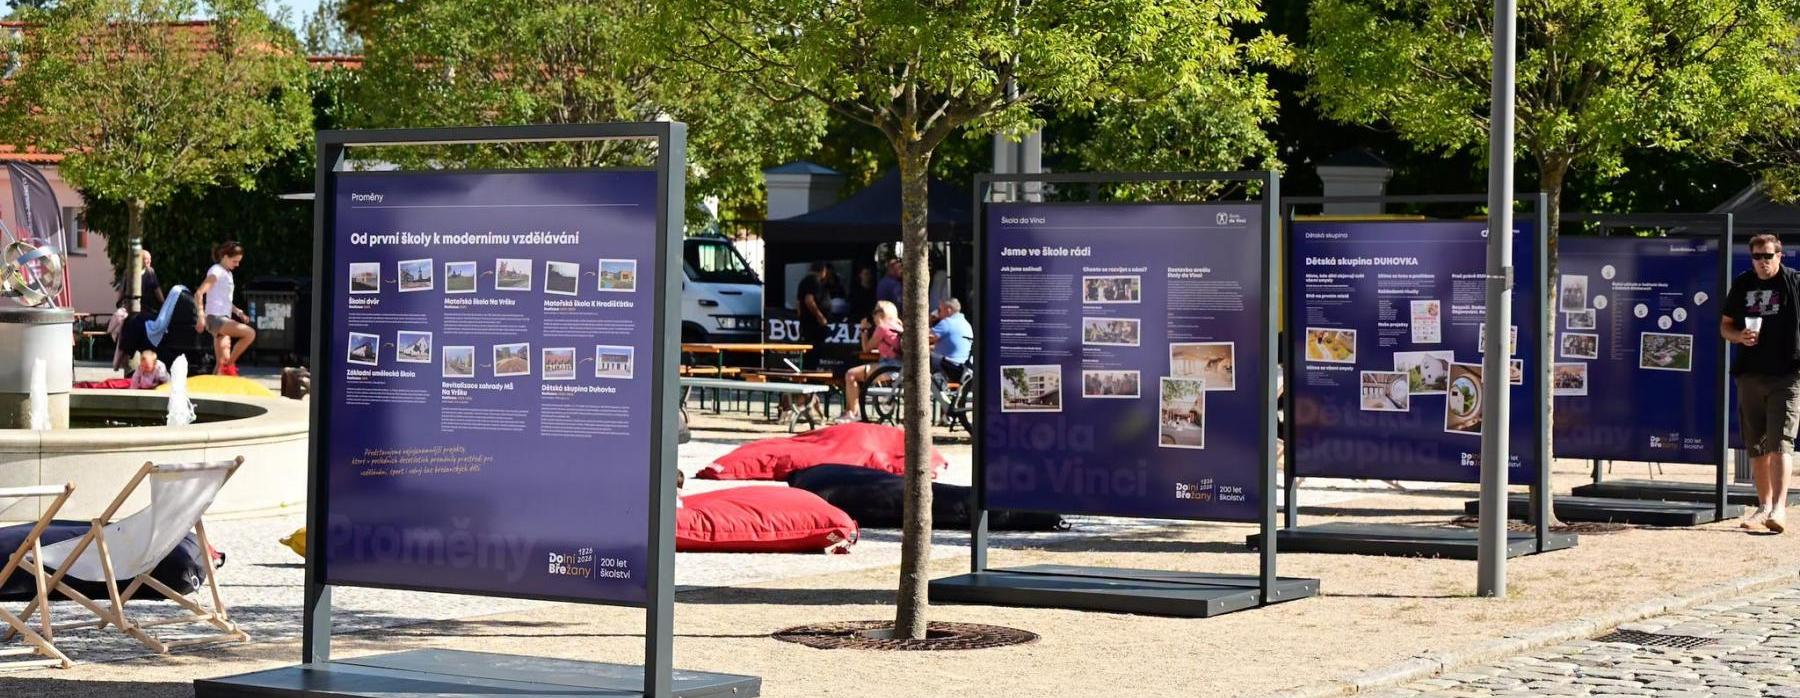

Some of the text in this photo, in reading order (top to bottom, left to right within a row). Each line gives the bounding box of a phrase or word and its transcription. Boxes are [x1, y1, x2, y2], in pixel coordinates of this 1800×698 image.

[351, 192, 384, 203] Proměny
[1030, 216, 1046, 224] Vinci
[350, 230, 580, 248] Od první školy k modernímu vzdělávání
[1000, 245, 1091, 257] Jsme ve škole rádi
[1305, 256, 1418, 267] Dětská skupina DUHOVKA
[348, 296, 380, 305] Školní dvůr
[443, 297, 516, 306] Mateřská škola Na Vršku
[543, 299, 573, 308] Mateřská
[573, 299, 590, 308] škola
[346, 368, 416, 378] Základní umělecká škola
[441, 381, 478, 390] Revitalizace
[478, 382, 504, 391] zahrady
[541, 383, 616, 394] Dětská skupina Duhovka
[451, 388, 468, 397] Vršku
[1175, 482, 1199, 491] Dolní
[1232, 486, 1242, 494] let
[1175, 490, 1212, 501] Břežany
[1219, 493, 1245, 502] školství
[548, 551, 576, 564] Dolní
[577, 554, 593, 564] 2026
[600, 557, 627, 568] 200 let
[548, 562, 591, 578] Břežany
[600, 568, 631, 579] školství
